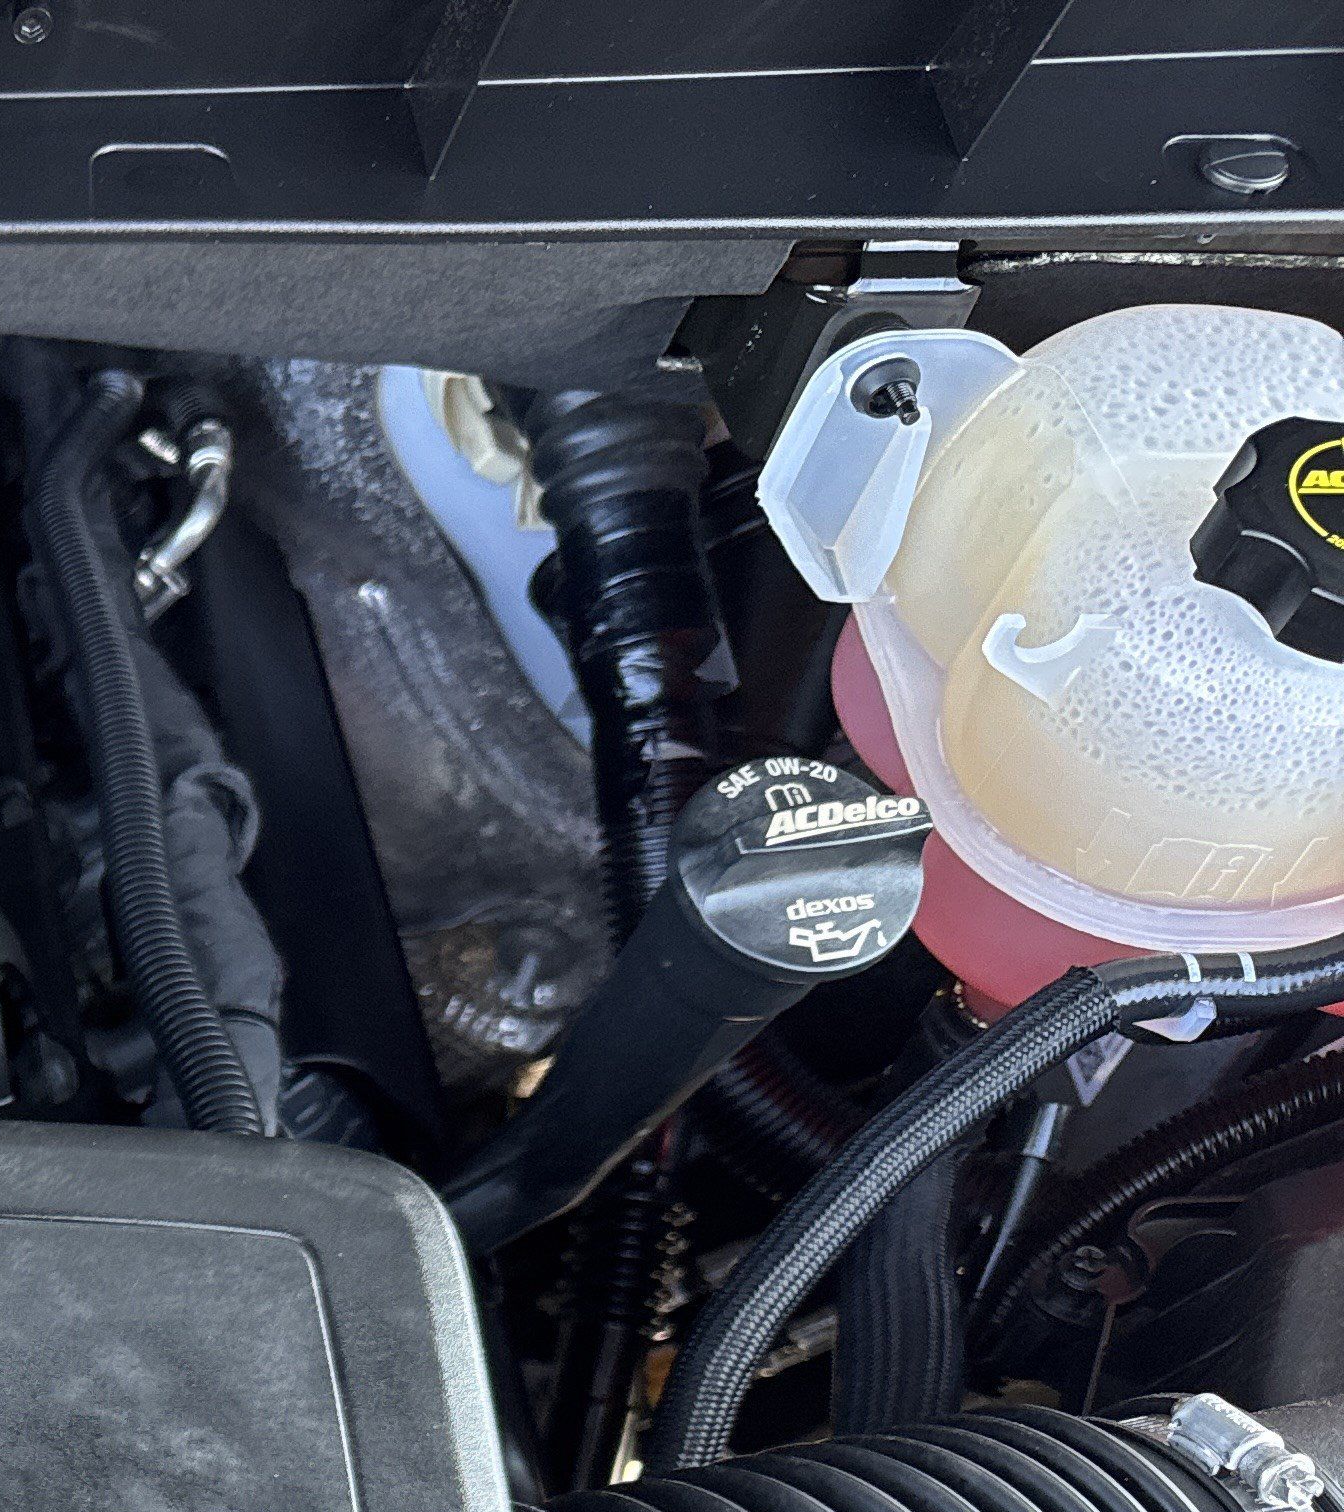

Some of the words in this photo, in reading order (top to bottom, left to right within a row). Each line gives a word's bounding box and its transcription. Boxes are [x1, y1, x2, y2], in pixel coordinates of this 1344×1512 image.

[716, 764, 761, 799] SAE
[764, 757, 838, 783] 0W-20
[765, 796, 920, 839] ACDelco
[786, 893, 875, 921] dexos
